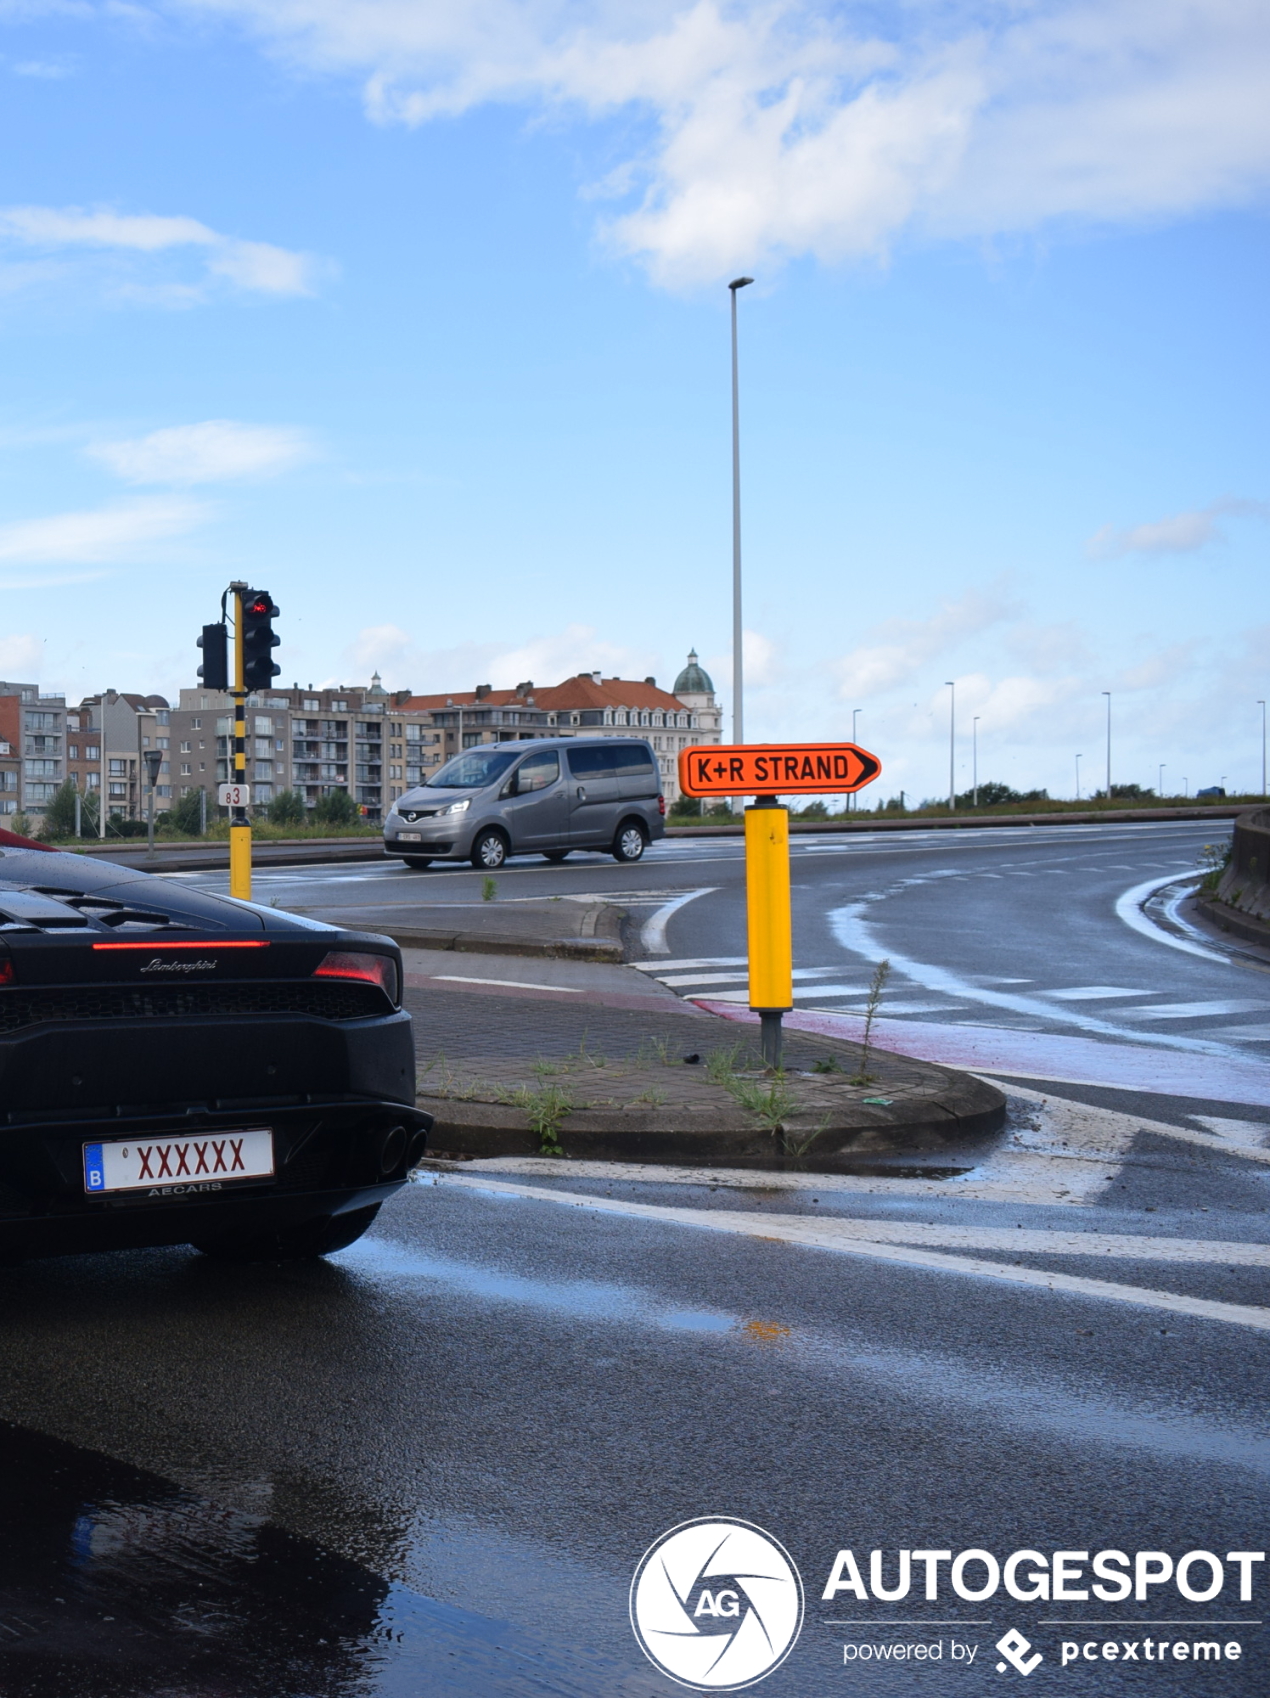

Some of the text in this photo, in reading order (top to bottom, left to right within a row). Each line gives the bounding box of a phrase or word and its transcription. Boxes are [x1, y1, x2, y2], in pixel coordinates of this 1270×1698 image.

[698, 755, 848, 783] K+R STRAND
[140, 958, 218, 974] Lamborghini
[136, 1138, 246, 1180] XXXXXX
[90, 1170, 102, 1187] B
[147, 1182, 223, 1198] AECARS
